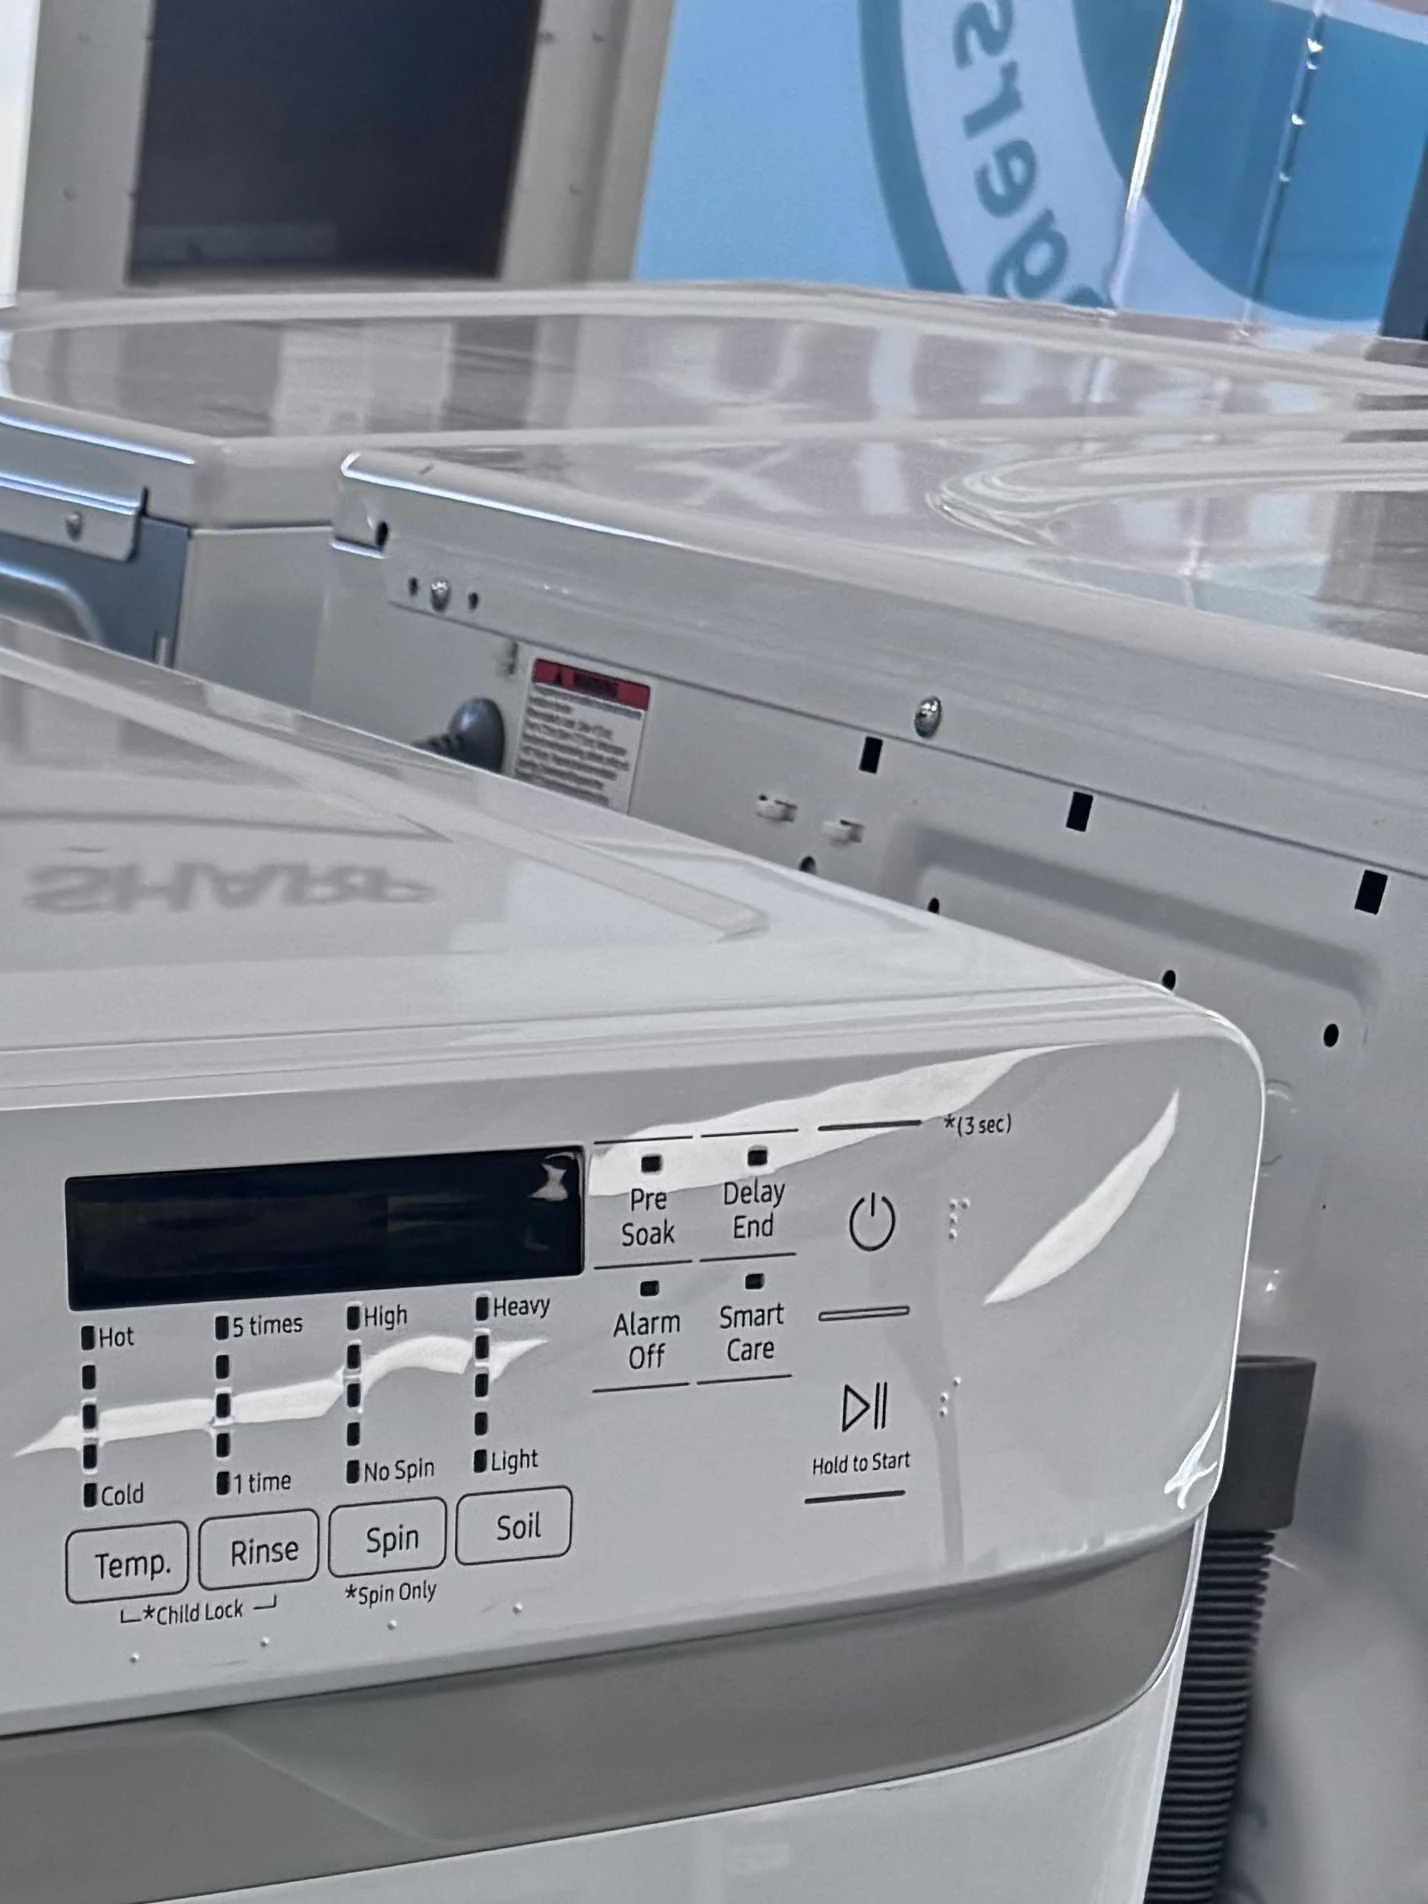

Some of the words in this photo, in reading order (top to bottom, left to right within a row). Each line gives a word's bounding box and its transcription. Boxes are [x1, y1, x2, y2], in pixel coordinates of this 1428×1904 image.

[630, 1188, 668, 1212] Pre
[723, 1177, 786, 1209] Delay
[621, 1218, 675, 1247] Soak
[733, 1211, 774, 1239] End
[364, 1303, 408, 1331] High
[493, 1296, 551, 1319] Heavy
[719, 1302, 785, 1330] Smart
[99, 1326, 135, 1349] Hot
[233, 1316, 244, 1338] 5
[249, 1314, 303, 1337] times
[612, 1311, 681, 1338] Alarm
[629, 1342, 666, 1370] Off
[727, 1337, 775, 1362] Care
[364, 1462, 390, 1483] No
[394, 1457, 435, 1484] Spin
[491, 1448, 539, 1475] Light
[812, 1454, 849, 1476] Hold
[853, 1455, 868, 1473] to
[872, 1451, 911, 1471] Start
[101, 1481, 144, 1507] Cold
[234, 1473, 242, 1495] 1
[248, 1471, 292, 1494] time
[496, 1511, 542, 1541] Soil
[231, 1538, 299, 1567] Rinse
[366, 1523, 419, 1559] Spin
[94, 1552, 171, 1581] Temp.
[399, 1579, 437, 1604] Only
[205, 1598, 244, 1621] Lock
